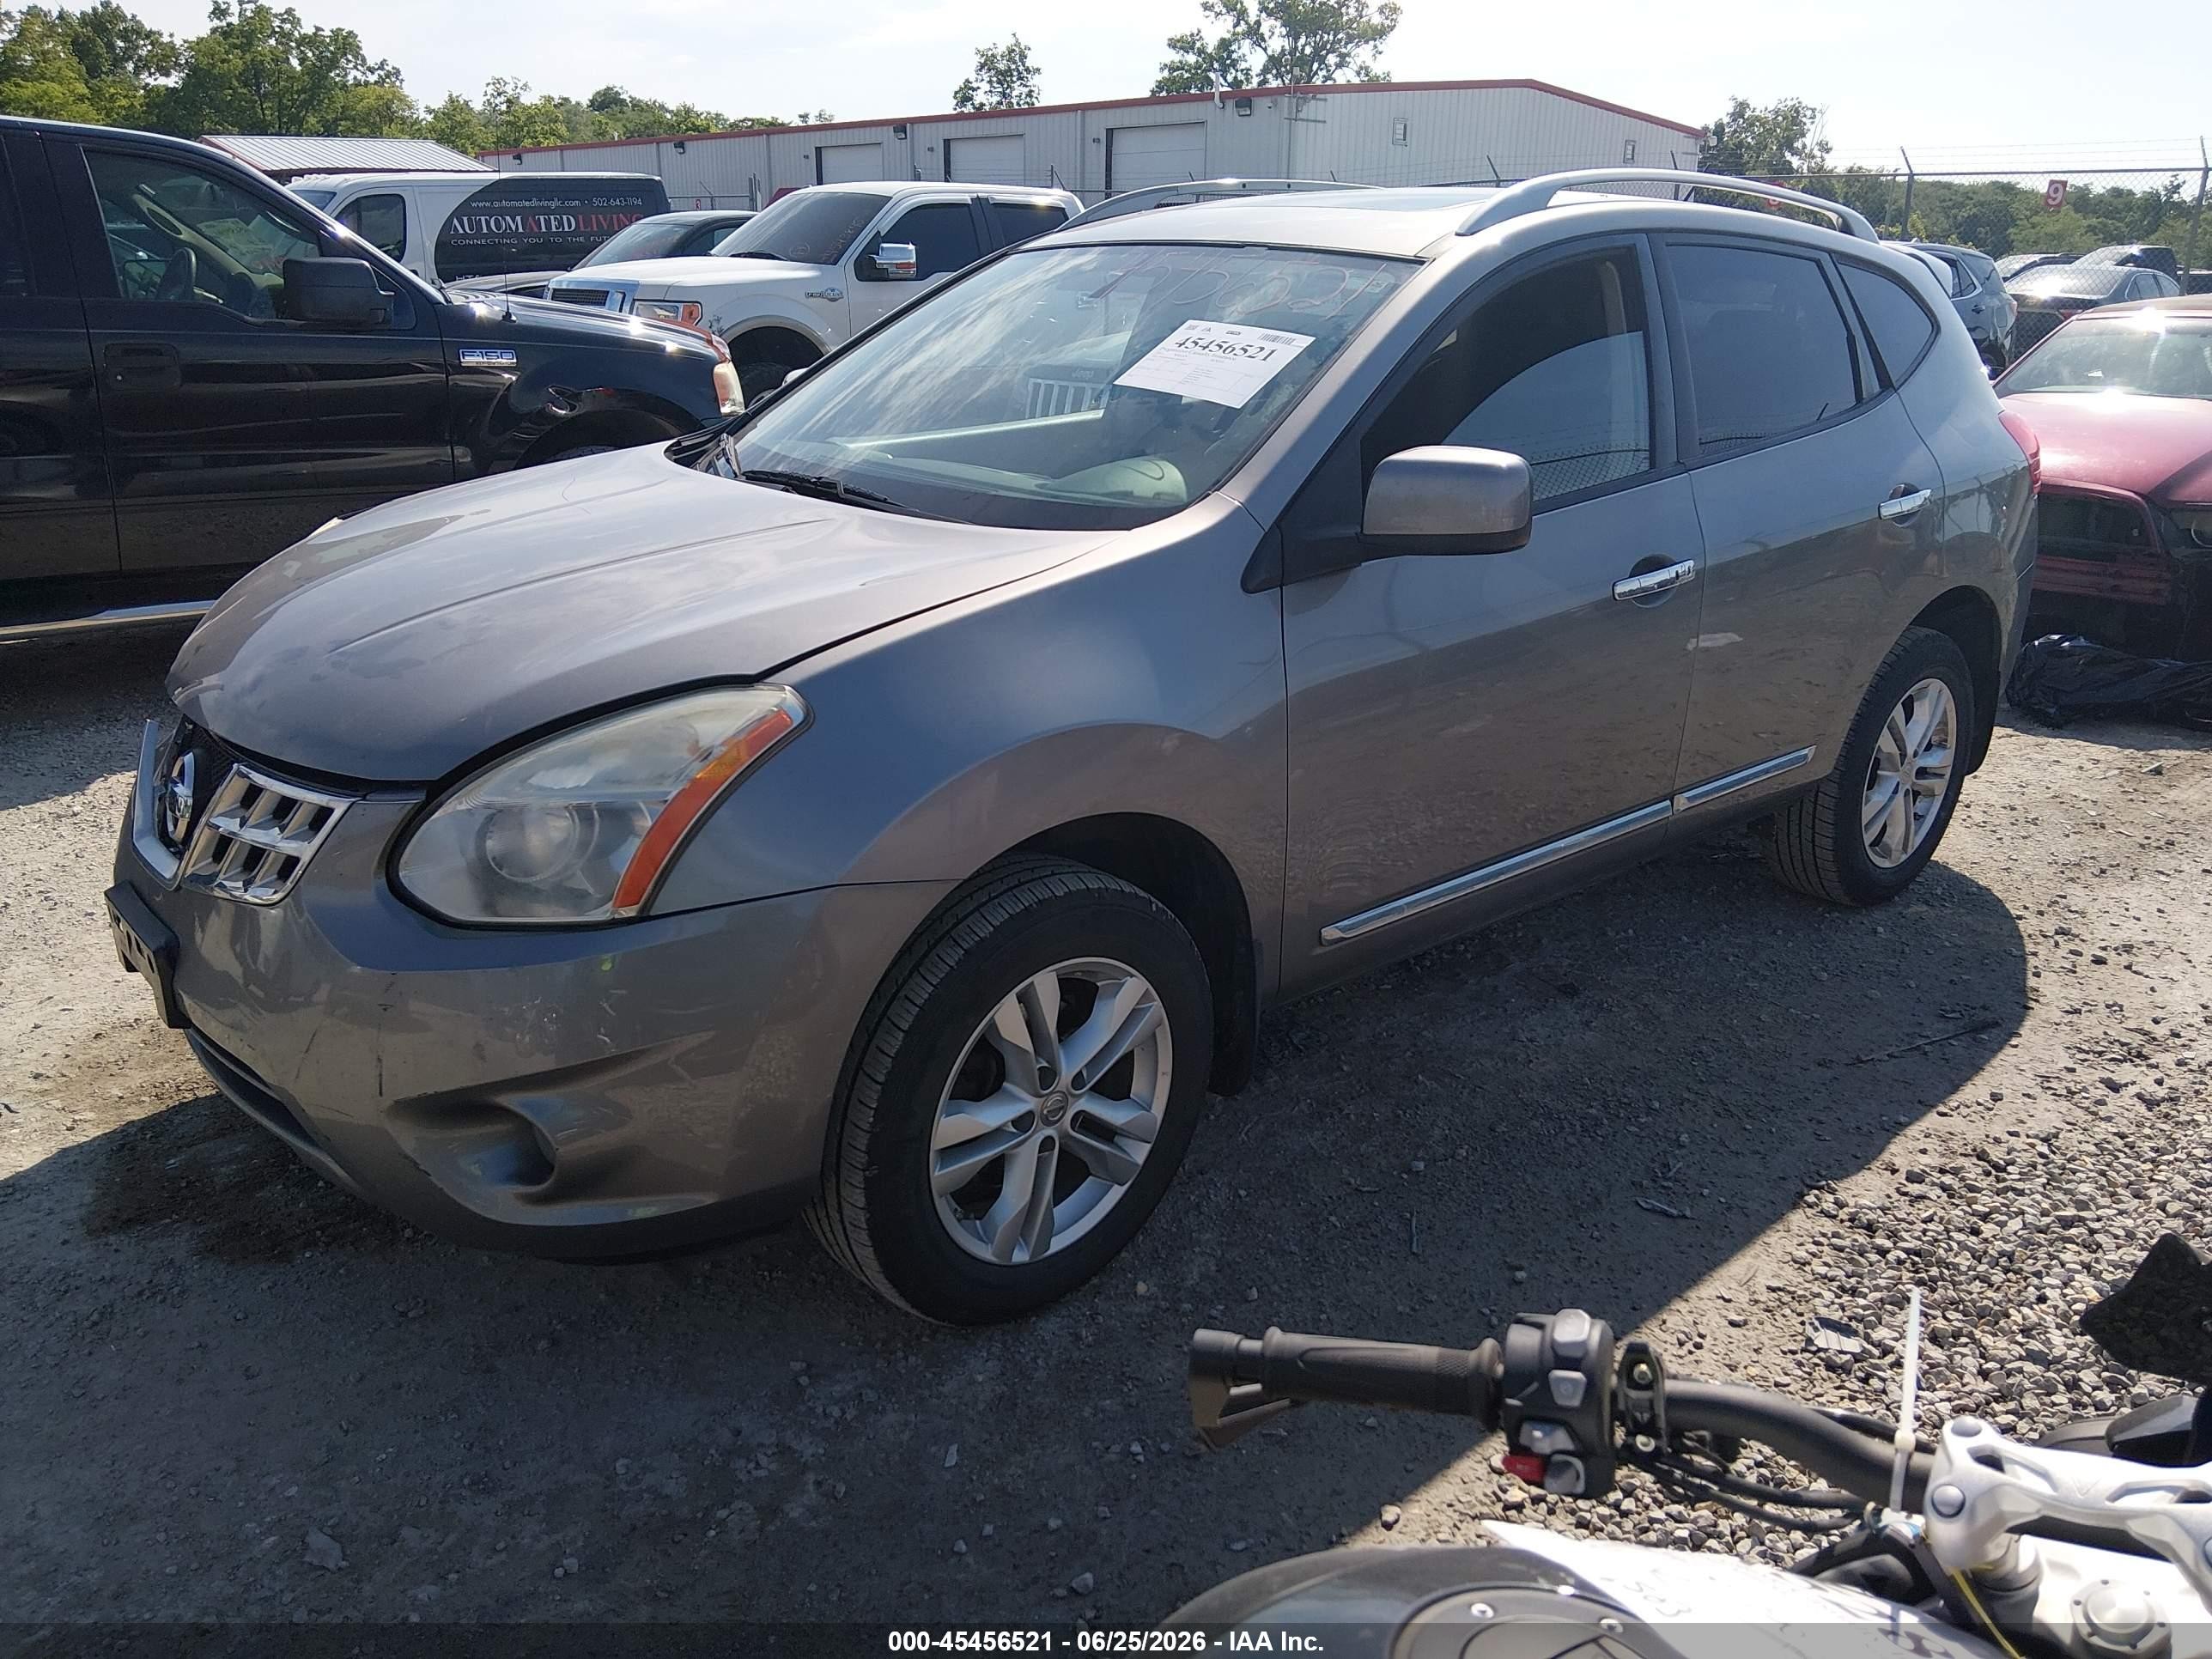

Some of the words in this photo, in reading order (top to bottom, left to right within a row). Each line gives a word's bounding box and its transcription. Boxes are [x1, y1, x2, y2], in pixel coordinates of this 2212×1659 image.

[470, 198, 581, 210] www.automatedlivingllc.com
[592, 197, 642, 207] 502-643-1194
[2046, 183, 2063, 205] 9
[450, 214, 576, 234] AUTOMATED
[451, 237, 518, 246] CONNECTING
[1175, 336, 1279, 362] 45456521
